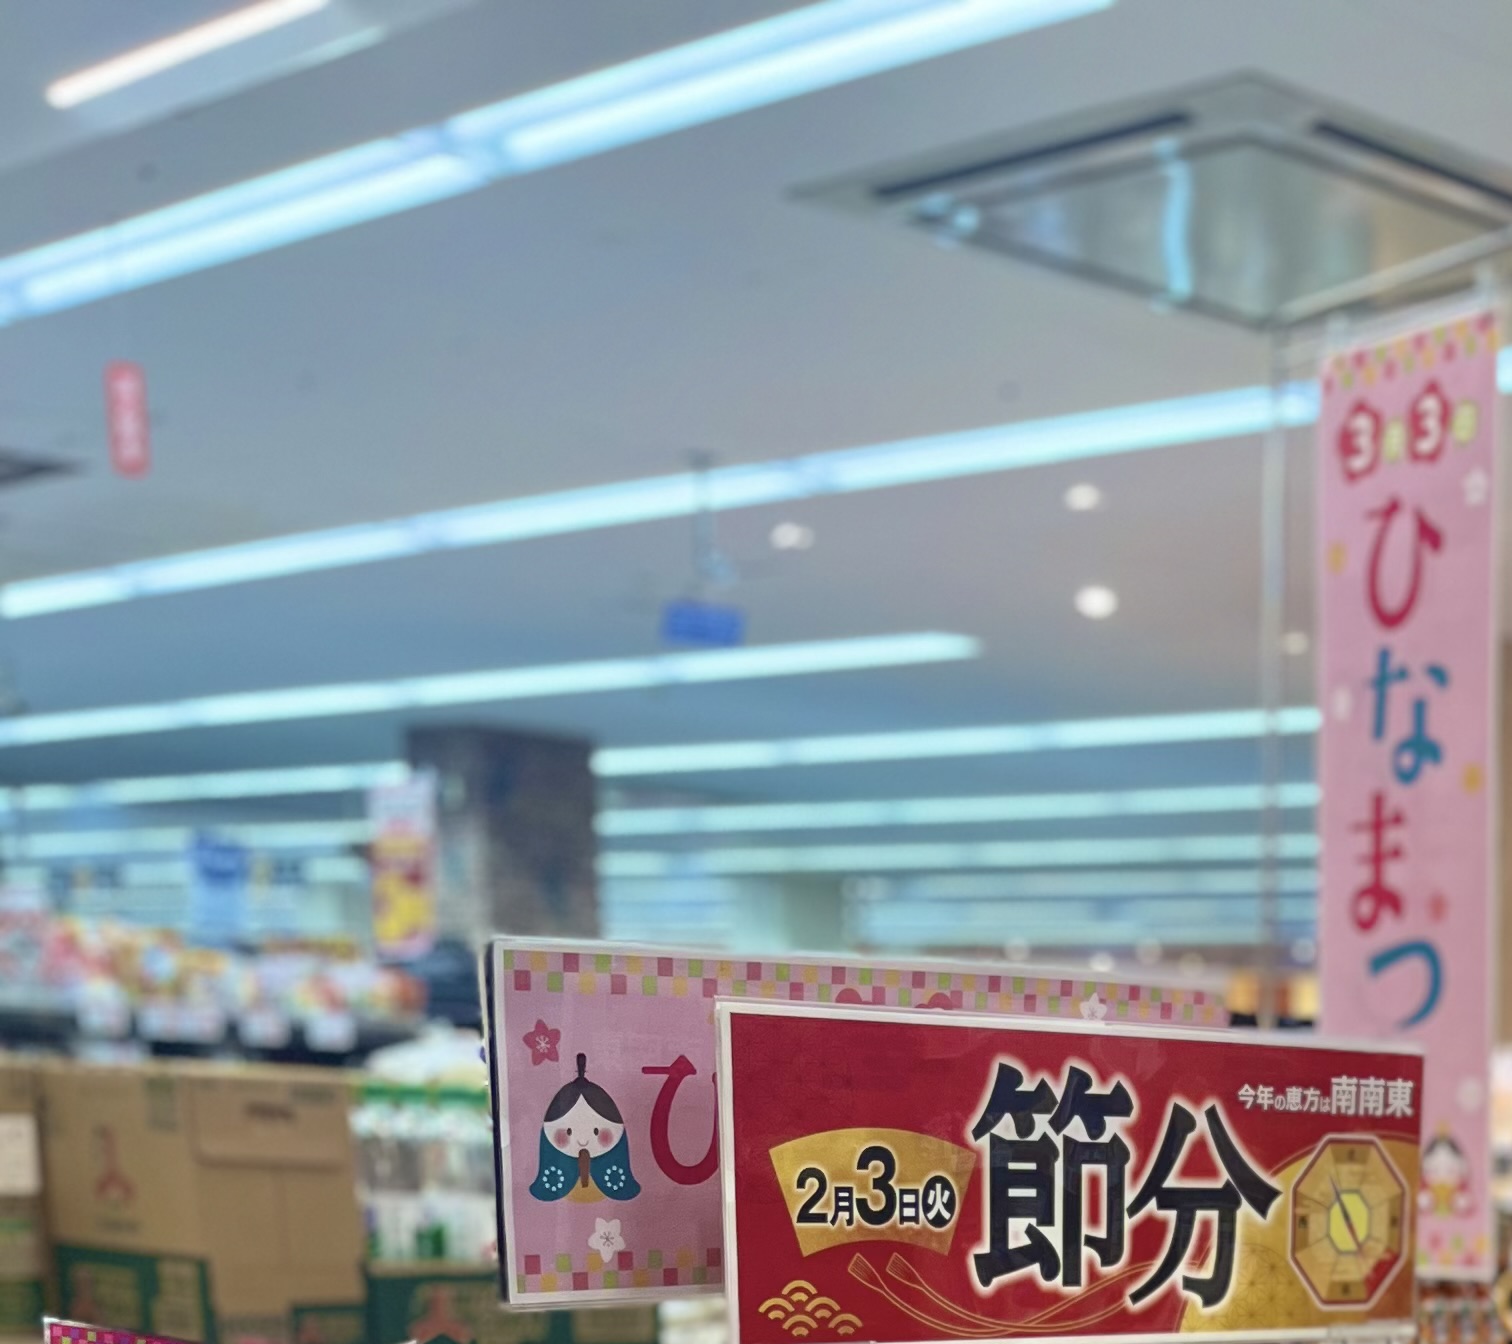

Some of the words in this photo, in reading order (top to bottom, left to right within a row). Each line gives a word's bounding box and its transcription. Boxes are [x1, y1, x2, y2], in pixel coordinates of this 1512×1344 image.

[1237, 1074, 1415, 1119] 今年の恵方は南南東
[970, 1060, 1282, 1308] 節分
